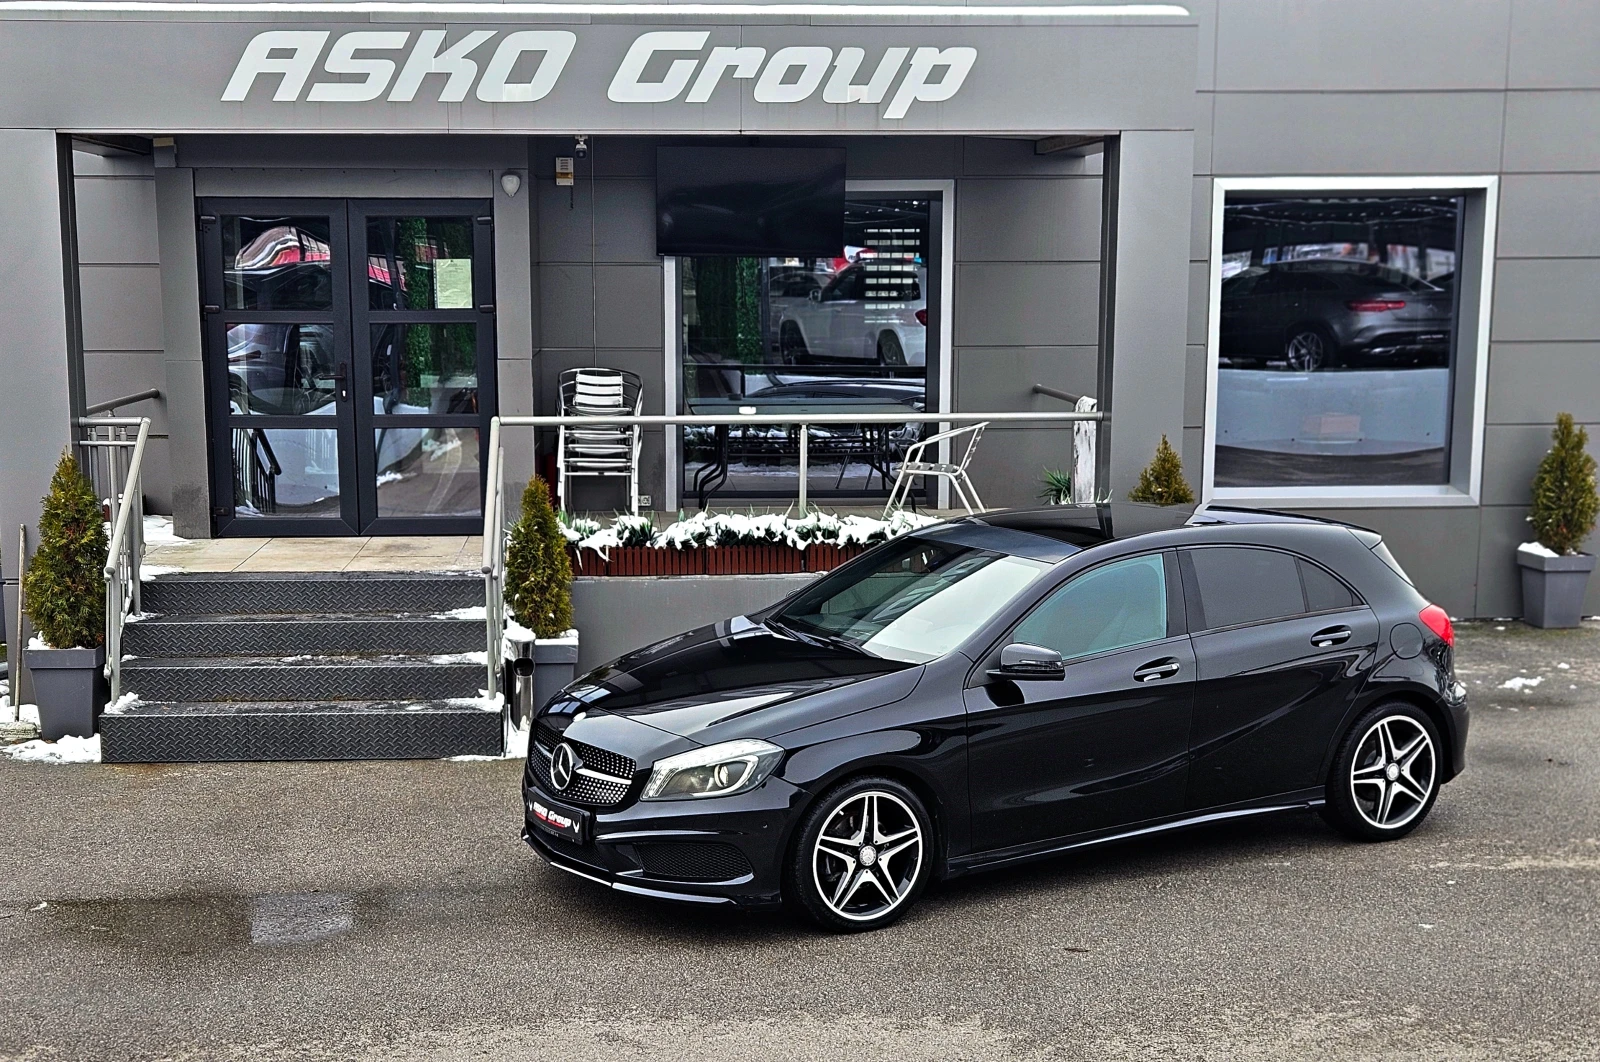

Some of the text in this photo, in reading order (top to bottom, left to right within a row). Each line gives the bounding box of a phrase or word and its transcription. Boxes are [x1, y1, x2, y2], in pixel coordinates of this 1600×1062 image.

[221, 30, 978, 119] ASKO Group
[547, 810, 572, 828] Group
